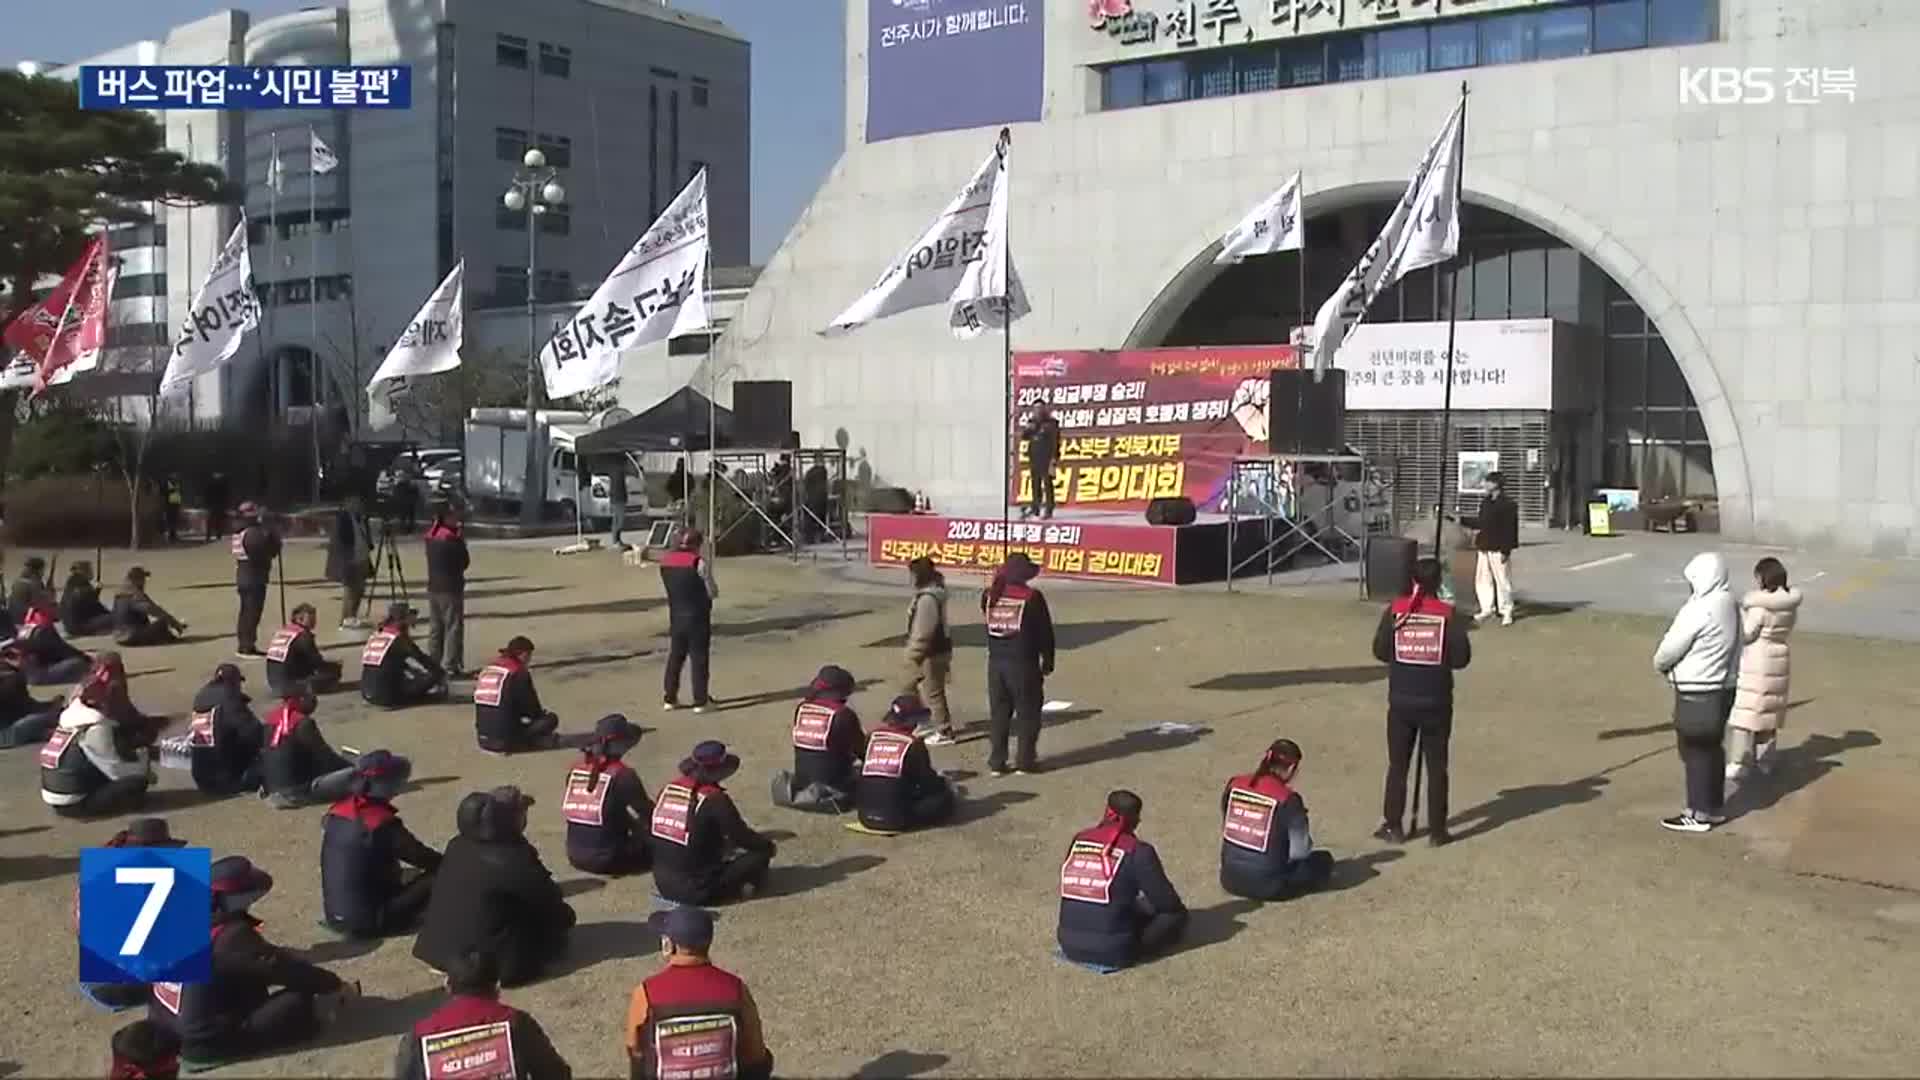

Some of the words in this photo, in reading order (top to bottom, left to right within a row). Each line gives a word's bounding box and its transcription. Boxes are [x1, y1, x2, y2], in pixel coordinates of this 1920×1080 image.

[881, 18, 942, 47] 전주시가
[945, 4, 1029, 35] 함께합니다.
[1345, 369, 1377, 387] 주의
[1053, 383, 1108, 404] 임금투쟁
[1111, 381, 1147, 401] 승리!
[1191, 399, 1230, 420] 쟁취!
[1018, 435, 1111, 462] 민스본부
[1114, 433, 1182, 459] 전북지부
[1076, 462, 1186, 503] 결의대회
[947, 521, 981, 540] 2024
[983, 522, 1042, 543] 임금투쟁
[1045, 523, 1081, 545] 승리!
[1049, 549, 1085, 574] 파업
[1088, 550, 1162, 577] 결의대회
